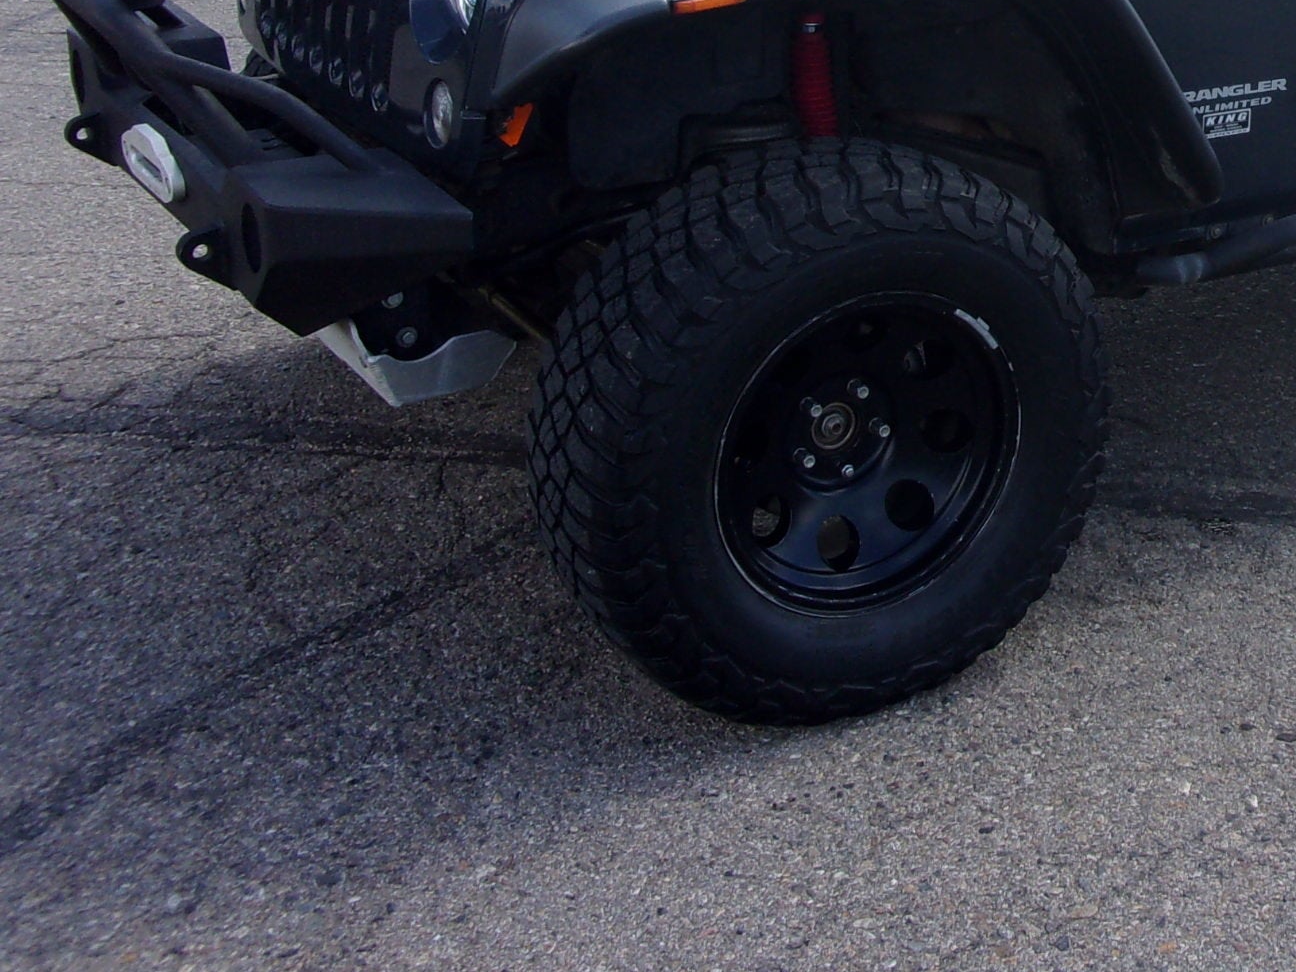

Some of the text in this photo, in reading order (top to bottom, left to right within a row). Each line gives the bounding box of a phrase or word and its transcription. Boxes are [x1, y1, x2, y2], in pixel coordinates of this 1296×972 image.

[1183, 78, 1288, 102] RANGLER
[1192, 96, 1272, 115] NLIMITED
[1206, 111, 1248, 127] KING
